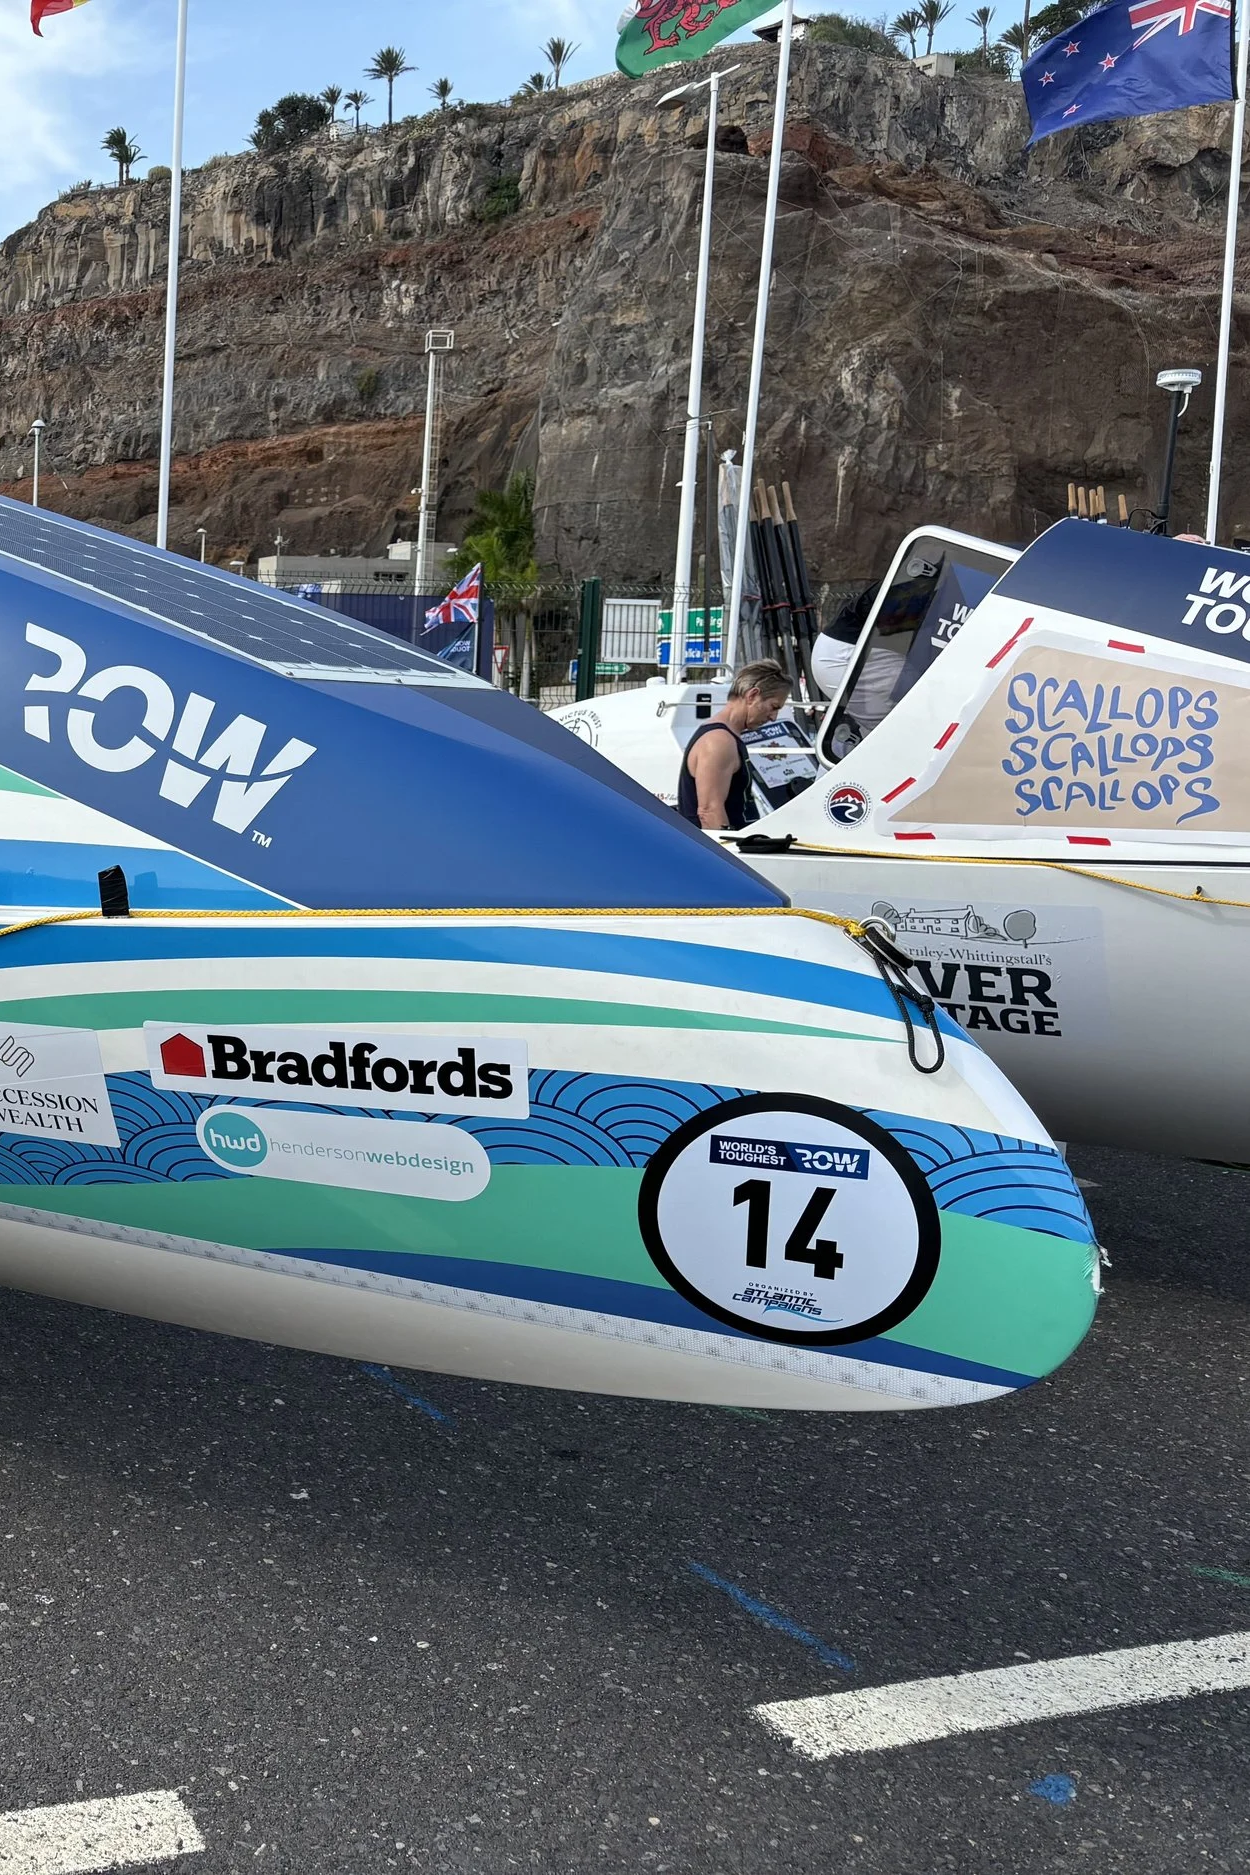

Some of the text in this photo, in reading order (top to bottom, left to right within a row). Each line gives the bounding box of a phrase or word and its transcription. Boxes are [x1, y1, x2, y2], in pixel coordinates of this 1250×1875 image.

[696, 617, 722, 628] Paing
[1005, 672, 1219, 734] SCALLOPS
[23, 622, 318, 835] ROW
[1002, 733, 1214, 777] SCALLOPS
[1015, 774, 1221, 826] SCALLOPS
[904, 947, 1052, 966] rnley-Whittingstall's
[913, 960, 1058, 1008] VER
[938, 1002, 1063, 1037] TAGE
[207, 1034, 513, 1100] Bradfords
[210, 1127, 474, 1176] hwd hendersonwebdesign
[719, 1140, 777, 1155] WORLD'S
[719, 1148, 861, 1174] TOUGHEST ROW
[733, 1178, 844, 1280] 14
[748, 1282, 800, 1295] ORGANIZED
